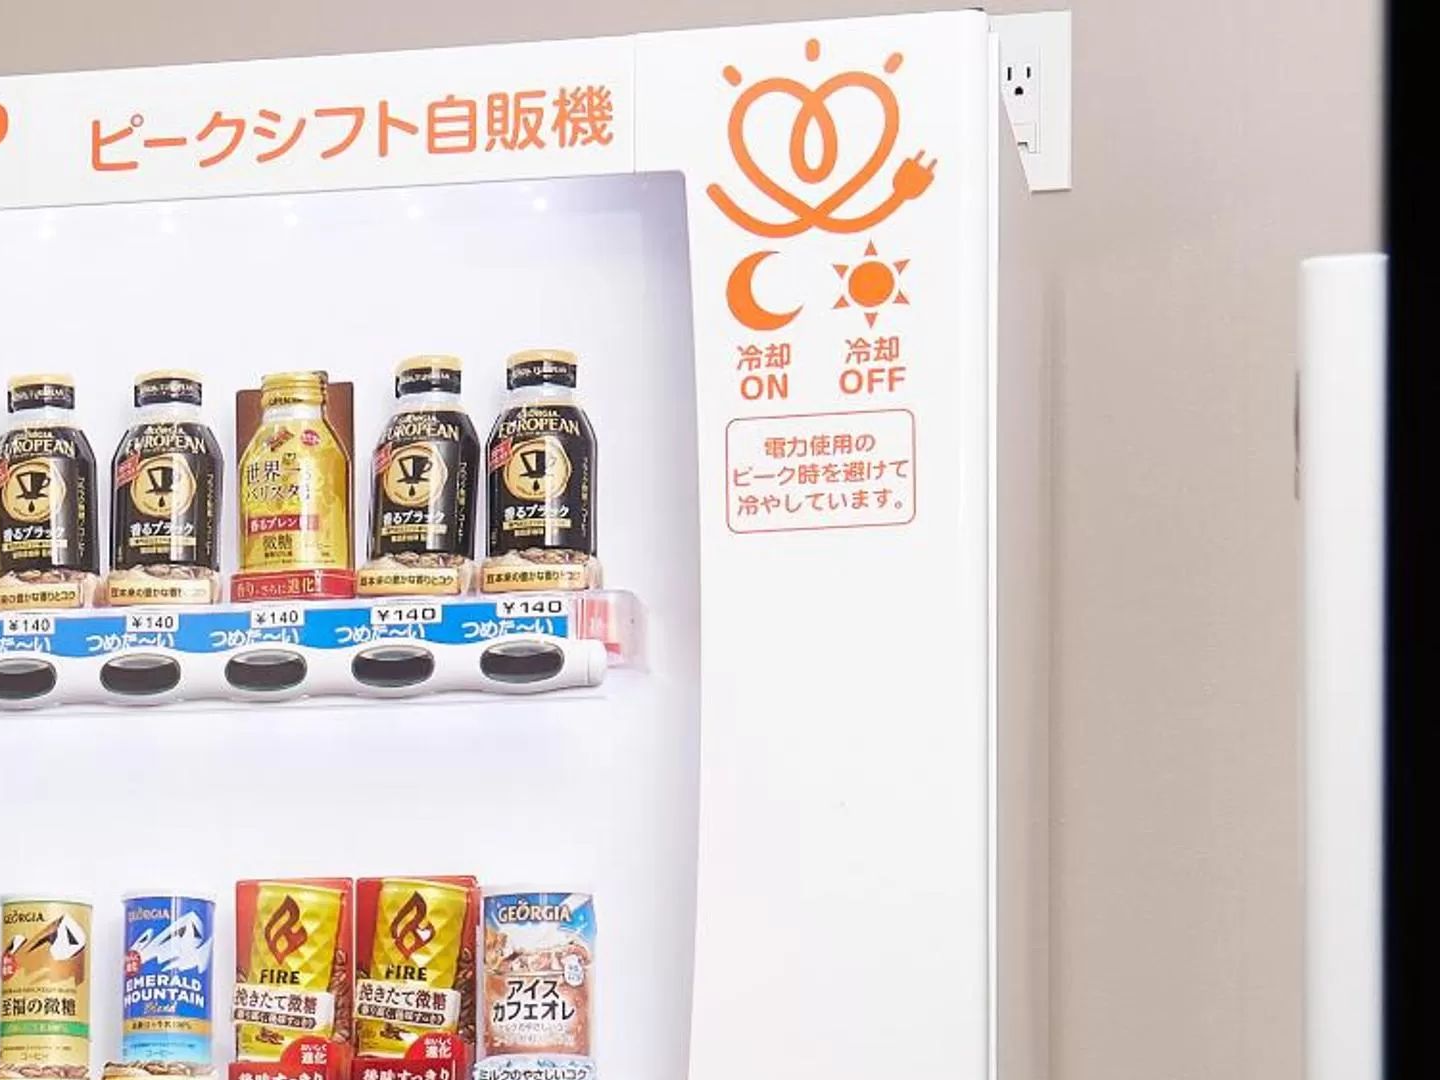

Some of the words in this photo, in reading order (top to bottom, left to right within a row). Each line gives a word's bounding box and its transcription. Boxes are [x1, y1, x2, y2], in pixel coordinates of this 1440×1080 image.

[91, 84, 615, 173] ピークシフト自販機
[737, 343, 791, 371] 冷却
[845, 336, 900, 364] 冷却
[740, 373, 789, 400] ON
[839, 367, 906, 394] OFF
[764, 434, 876, 459] 電力使用の
[733, 459, 909, 487] ピーク時を避けて
[737, 488, 904, 516] 冷やしています。
[256, 610, 299, 624] ¥140
[377, 607, 437, 621] ¥140
[502, 600, 562, 615] ¥140
[9, 619, 51, 633] ¥140
[132, 616, 174, 630] ¥140
[498, 900, 572, 924] GEORGIA
[126, 975, 202, 991] EMERALD
[260, 969, 301, 985] FIRE
[386, 966, 428, 981] FIRE
[124, 989, 204, 1008] MOUNTAIN
[508, 979, 560, 1000] アイス
[493, 1001, 576, 1023] カフェオレ
[478, 1068, 587, 1080] ミルクのやさしいコク
